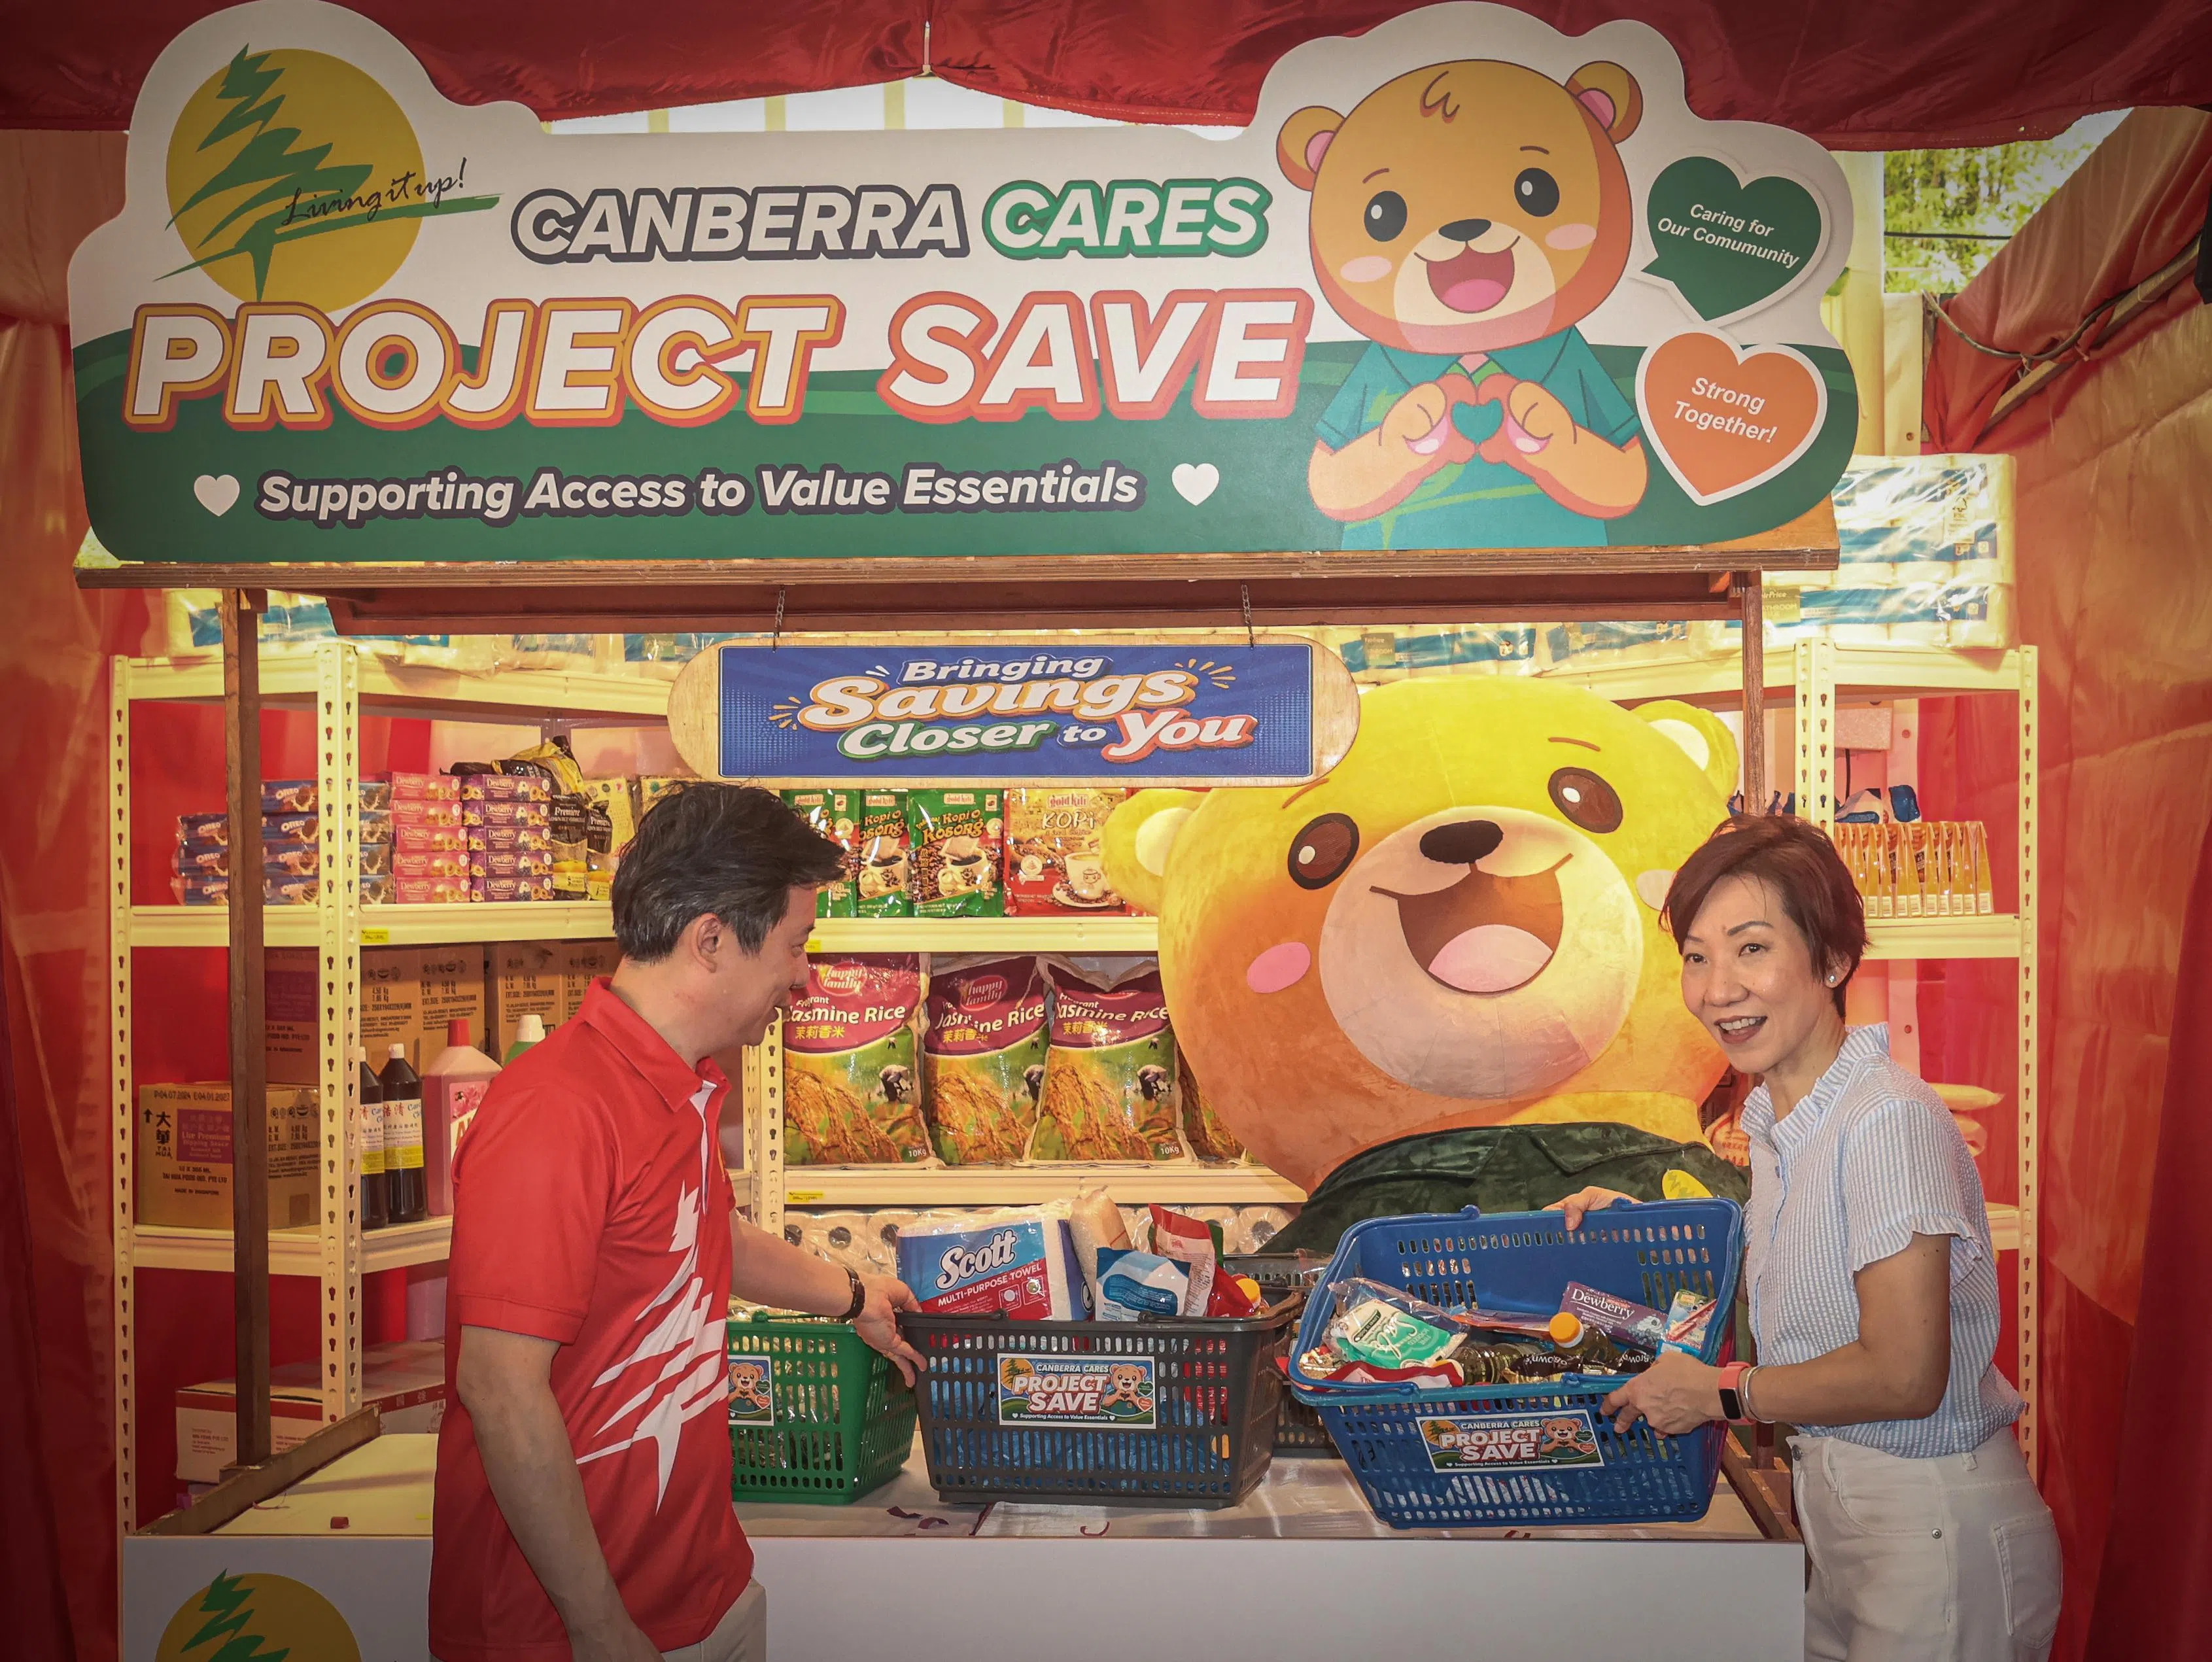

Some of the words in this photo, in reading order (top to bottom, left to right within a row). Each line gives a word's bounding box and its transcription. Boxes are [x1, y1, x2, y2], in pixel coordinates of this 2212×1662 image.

[282, 186, 383, 226] Living
[415, 158, 468, 198] up!
[514, 187, 967, 260] CANBERRA
[986, 182, 1269, 256] CARES
[1690, 203, 1746, 234] Caring
[1749, 218, 1774, 237] for
[1658, 216, 1690, 238] Our
[1693, 228, 1800, 269] Comumunity
[128, 302, 838, 424] PROJECT
[882, 294, 1307, 416] SAVE
[1692, 377, 1766, 415] Strong
[1674, 401, 1778, 443] Together!
[260, 471, 514, 522] Supporting
[525, 472, 685, 510] Access
[699, 472, 746, 508] to
[763, 470, 890, 507] Value
[904, 464, 1139, 506] Essentials
[904, 655, 1104, 681] Bringing
[799, 670, 1194, 726] Savings
[842, 721, 1053, 756] Closer
[1062, 724, 1106, 744] to
[1105, 711, 1252, 757] You
[487, 778, 515, 788] Dewberry
[275, 788, 299, 799] OREO
[1050, 795, 1070, 807] gold
[485, 804, 513, 814] Dewberry
[942, 810, 969, 824] Kopi
[281, 820, 305, 832] OREO
[865, 812, 892, 825] Kopi
[198, 822, 222, 833] OREO
[488, 829, 516, 840] Dewberry
[859, 819, 906, 840] osong
[923, 818, 984, 846] Kosong
[196, 852, 220, 863] OREO
[488, 855, 516, 865] Dewberry
[487, 881, 516, 891] Dewberry
[826, 967, 864, 980] happy
[968, 980, 1003, 994] happy
[965, 990, 1003, 1006] family
[864, 1006, 907, 1023] Rice
[1007, 1001, 1045, 1028] Rice
[1130, 1005, 1169, 1022] Rice
[795, 1026, 845, 1040] 茉莉香米
[908, 1147, 927, 1158] 10Kg
[1160, 1145, 1180, 1155] 10Kg
[935, 1228, 1018, 1290] Scott
[937, 1275, 1008, 1307] MULTI-PURPOSE
[1010, 1263, 1042, 1281] TOWEL
[1571, 1288, 1635, 1321] Dewberry
[1036, 1363, 1080, 1373] CANBERRA
[1083, 1364, 1109, 1374] CARES
[1012, 1374, 1109, 1393] PROJECT
[1029, 1391, 1101, 1411] SAVE
[1019, 1413, 1046, 1421] Supporting
[1460, 1421, 1510, 1430] CANBERRA
[1440, 1429, 1540, 1447] PROJECT
[1462, 1442, 1536, 1461] SAVE
